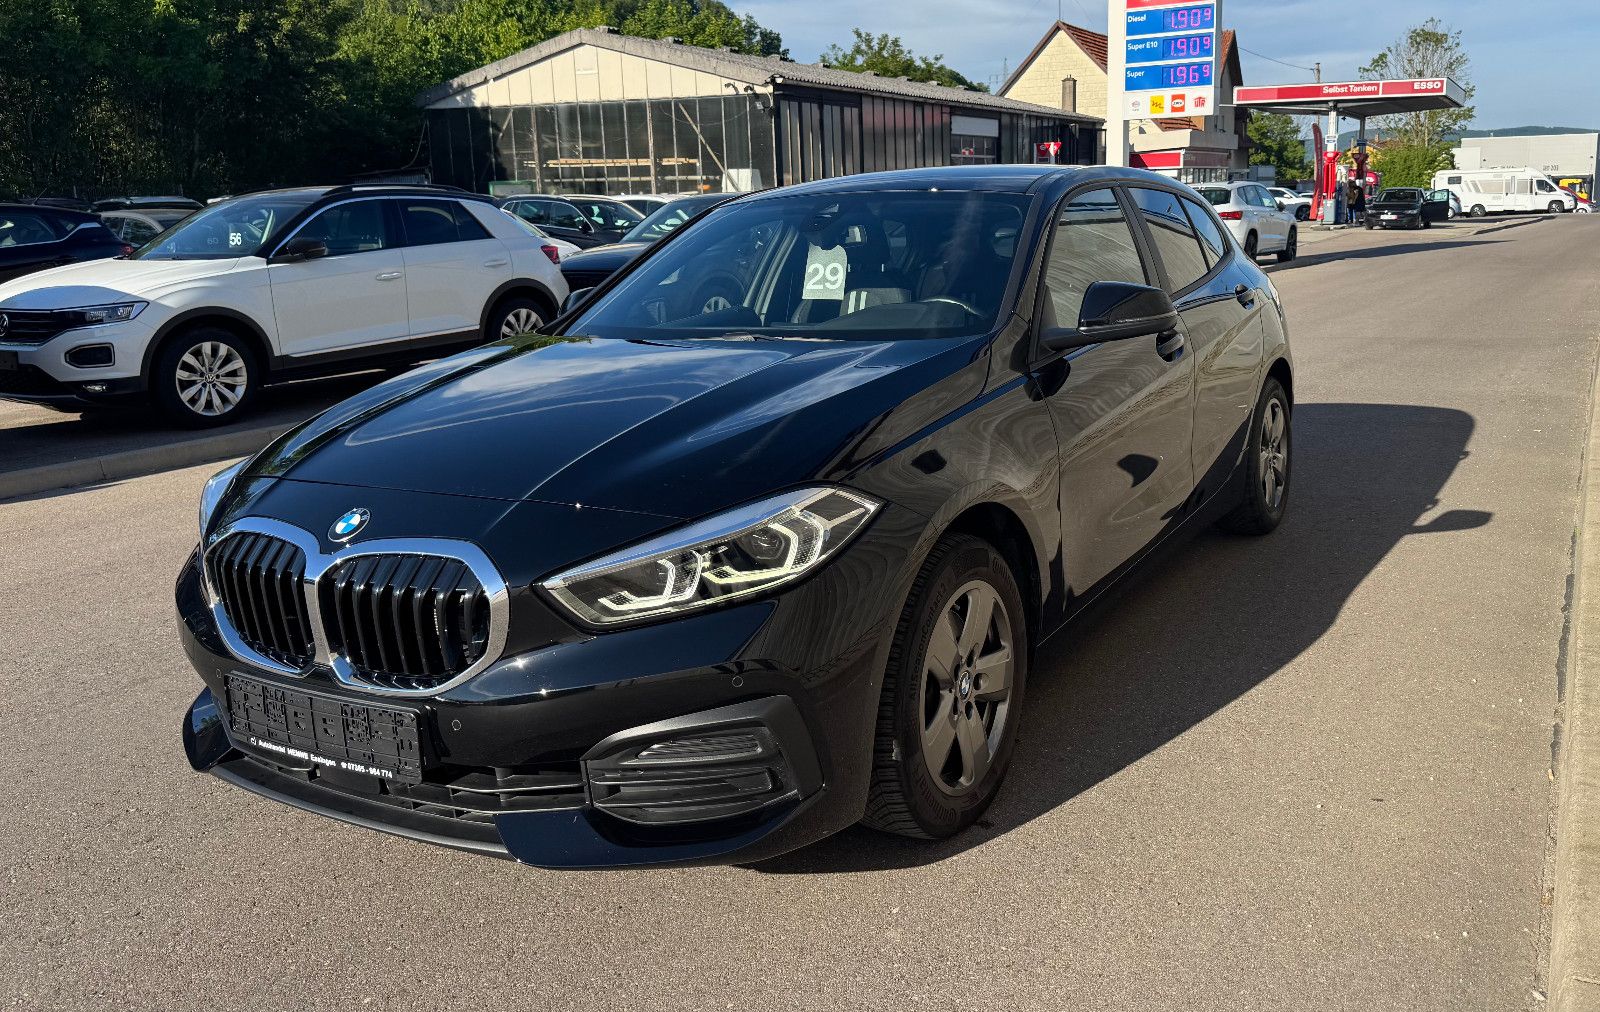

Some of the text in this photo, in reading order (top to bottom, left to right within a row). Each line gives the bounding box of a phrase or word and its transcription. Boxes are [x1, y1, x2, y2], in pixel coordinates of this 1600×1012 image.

[1127, 14, 1147, 23] Diesel
[1127, 43, 1145, 51] Super
[1146, 41, 1158, 49] E10
[1126, 70, 1145, 79] Super
[1322, 85, 1378, 94] Selbst Tanken
[1413, 81, 1441, 90] ESSO
[229, 232, 242, 246] 56
[806, 262, 844, 290] 29
